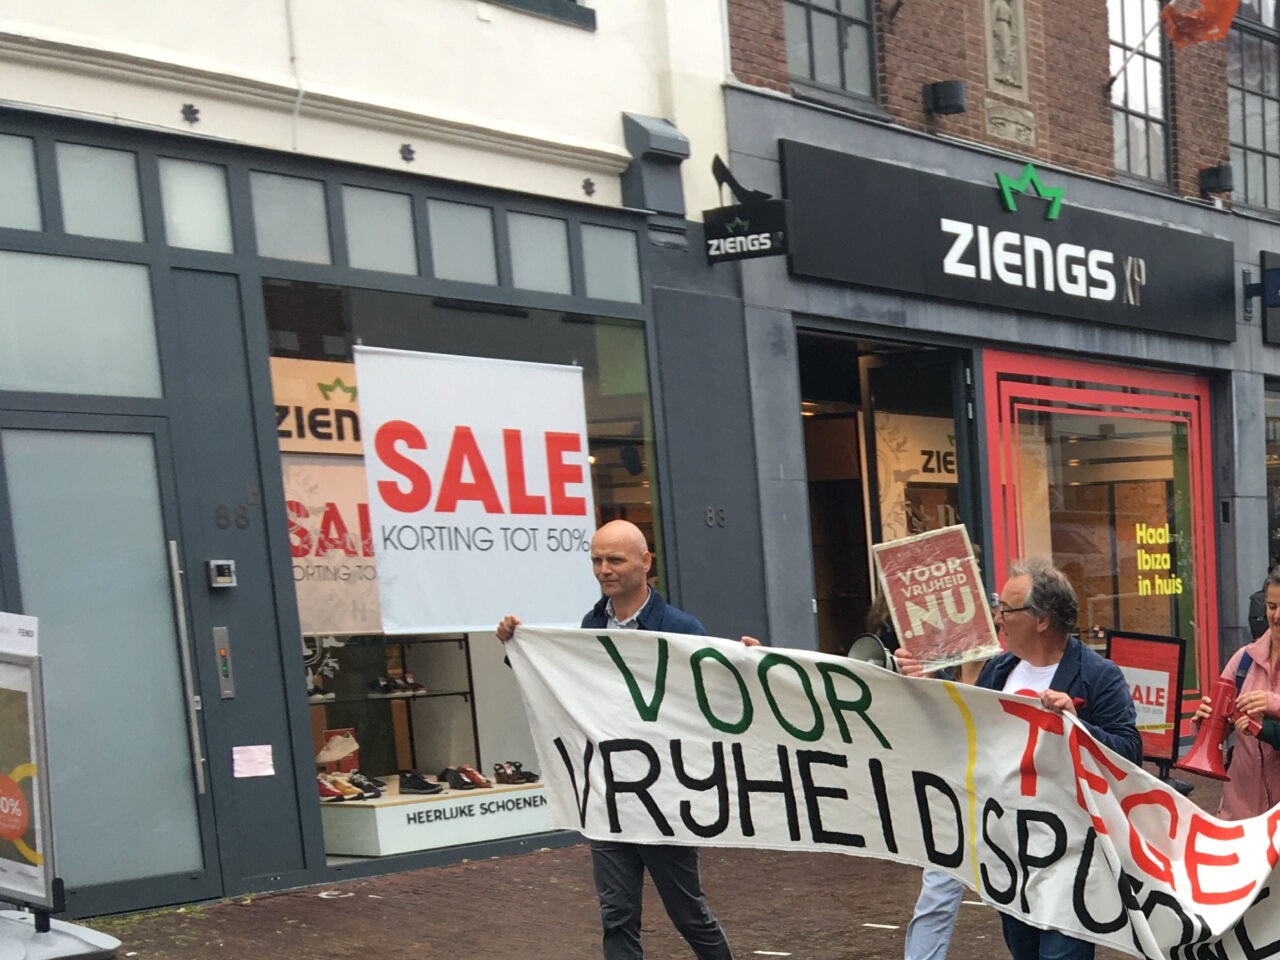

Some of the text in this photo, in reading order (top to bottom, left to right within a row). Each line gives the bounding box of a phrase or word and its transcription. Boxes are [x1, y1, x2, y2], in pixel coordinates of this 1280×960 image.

[707, 232, 772, 255] ZIENGS
[940, 217, 1117, 301] ZIENGS
[276, 405, 360, 442] ZIEN
[374, 420, 587, 516] SALE
[921, 450, 956, 474] ZIE
[381, 525, 590, 552] KORTING TOT 50%
[1136, 523, 1169, 544] Haal
[897, 556, 963, 586] VOOR
[1137, 549, 1171, 570] Ibiza
[293, 565, 350, 582] ORTING
[901, 573, 967, 598] VRIJHEID
[1138, 573, 1183, 596] in huis
[596, 635, 892, 750] VOOR
[1128, 684, 1165, 708] ALE
[0, 796, 22, 817] 0%
[407, 804, 476, 824] HEERLIJKE
